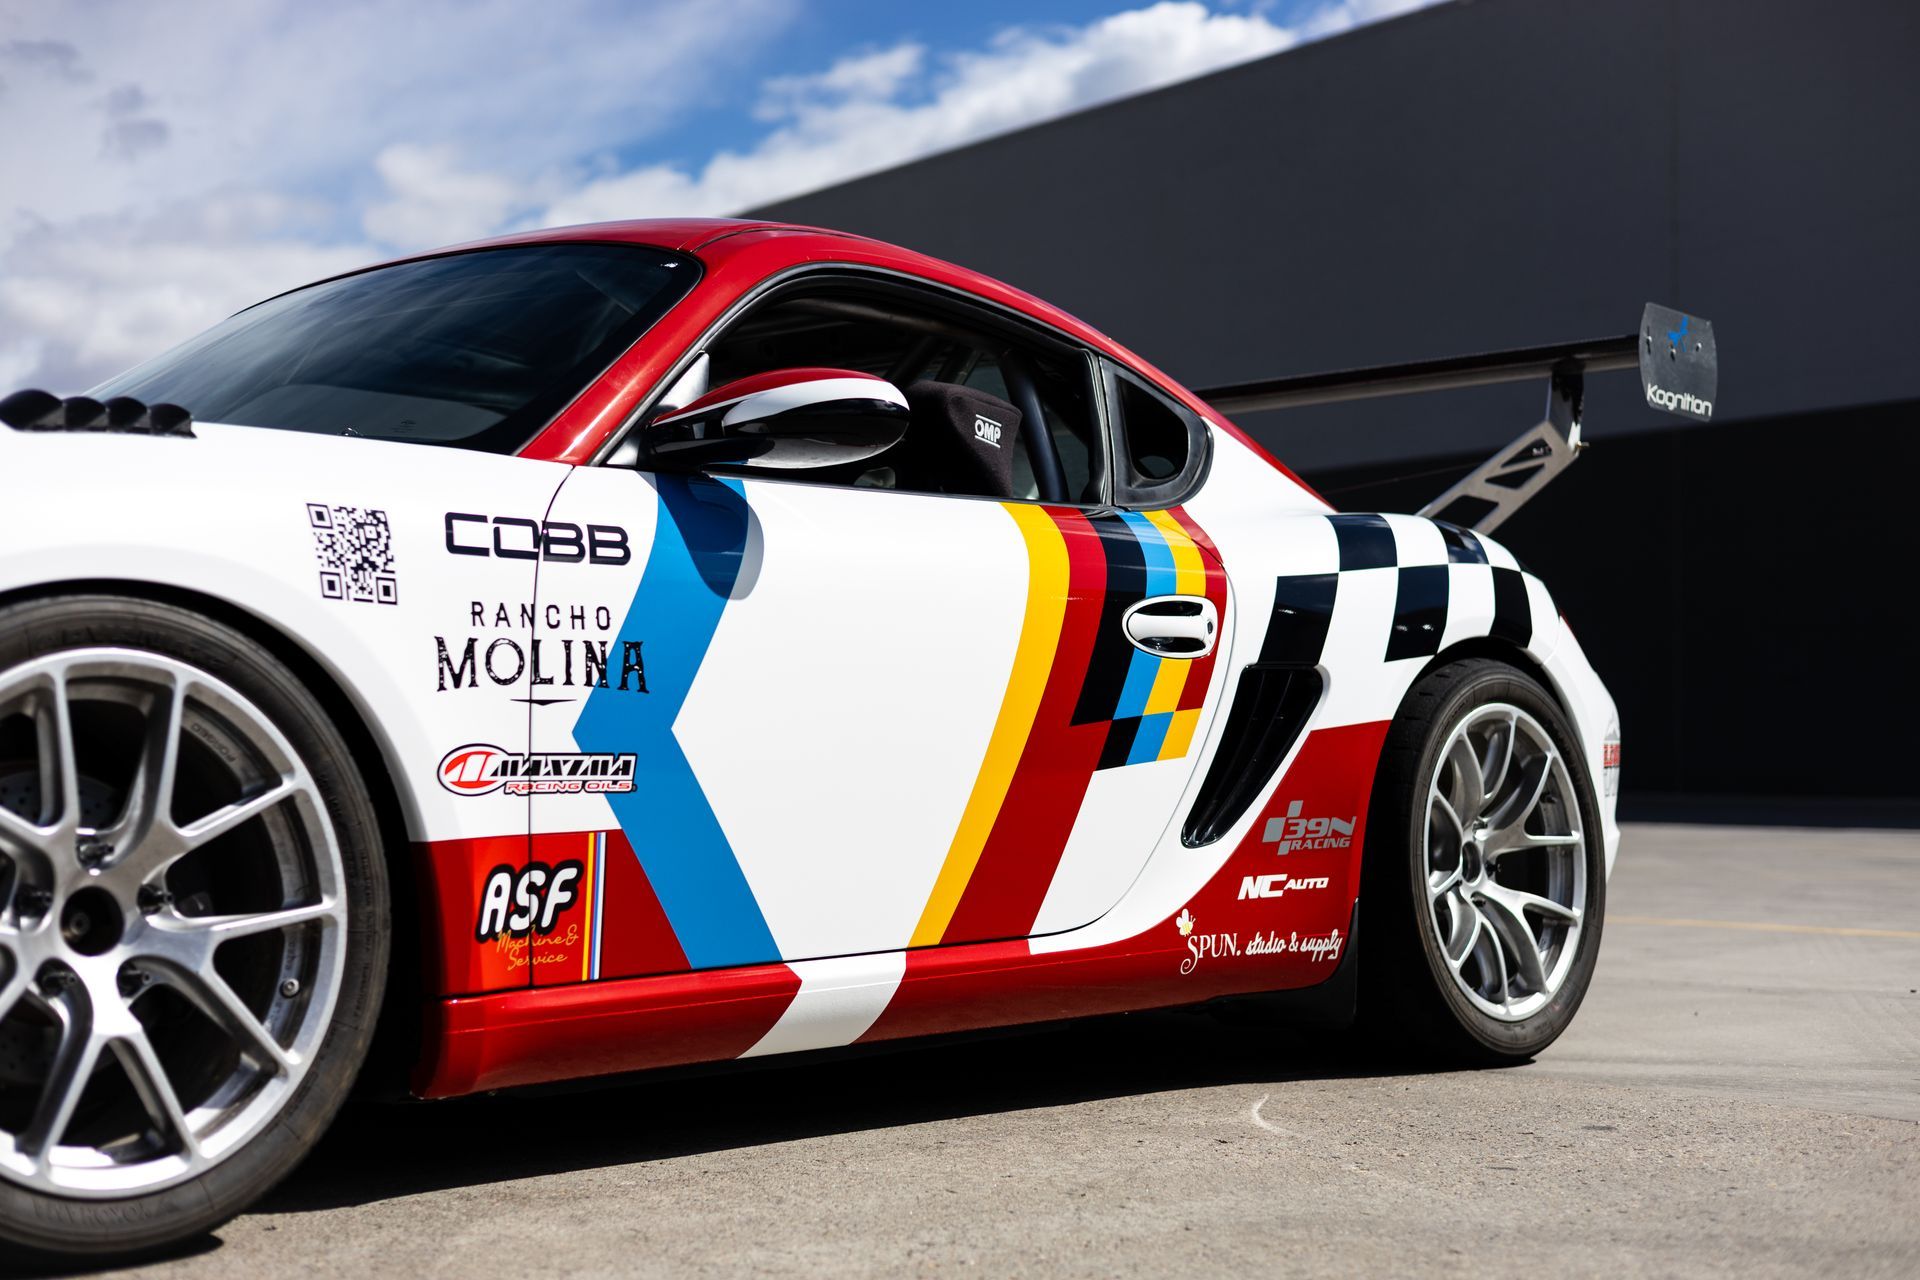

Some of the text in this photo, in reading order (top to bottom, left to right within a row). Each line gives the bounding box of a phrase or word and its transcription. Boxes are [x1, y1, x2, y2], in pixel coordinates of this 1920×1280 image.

[1646, 383, 1712, 417] Kognition
[975, 419, 1001, 443] OMP
[445, 512, 631, 566] COBB
[471, 601, 611, 630] RANCHO
[434, 635, 650, 694] MOLINA
[586, 782, 631, 792] OILS
[1284, 816, 1357, 839] 39N
[1290, 836, 1351, 850] RACING
[478, 864, 581, 938] ASF
[496, 923, 579, 954] Machine &
[1180, 928, 1343, 975] SPUN. studio & supply
[507, 947, 568, 971] Service
